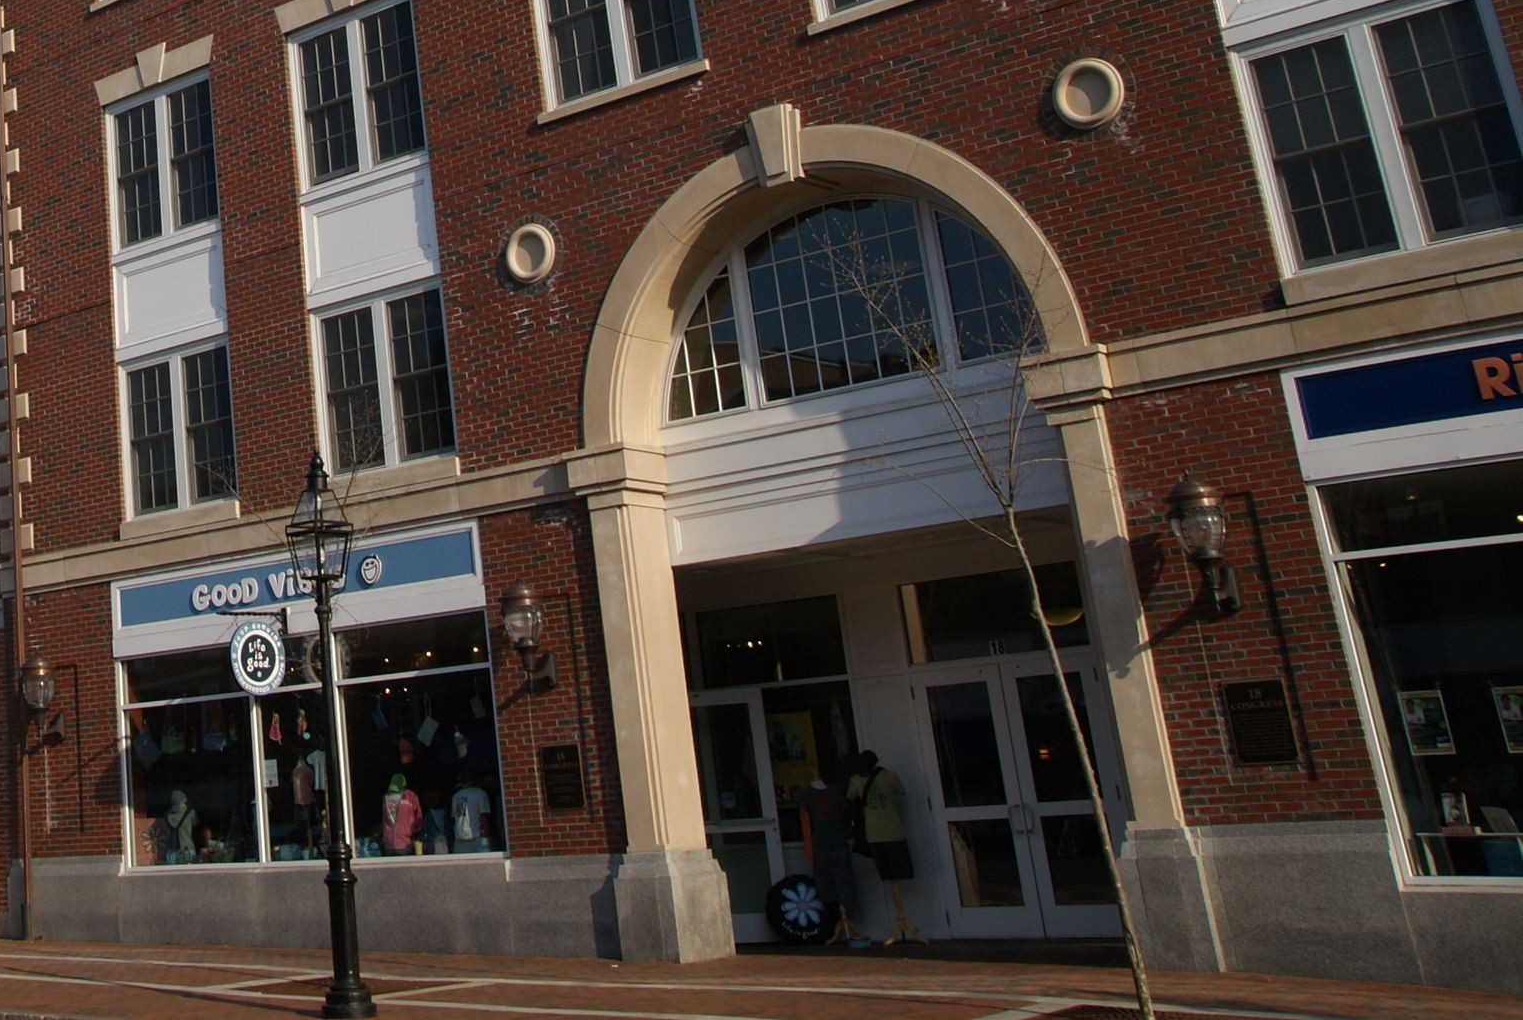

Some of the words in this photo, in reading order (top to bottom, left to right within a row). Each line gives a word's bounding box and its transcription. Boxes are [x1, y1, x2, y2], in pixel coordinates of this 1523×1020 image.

[248, 638, 266, 653] Life
[990, 640, 1005, 654] 18
[254, 651, 263, 660] is
